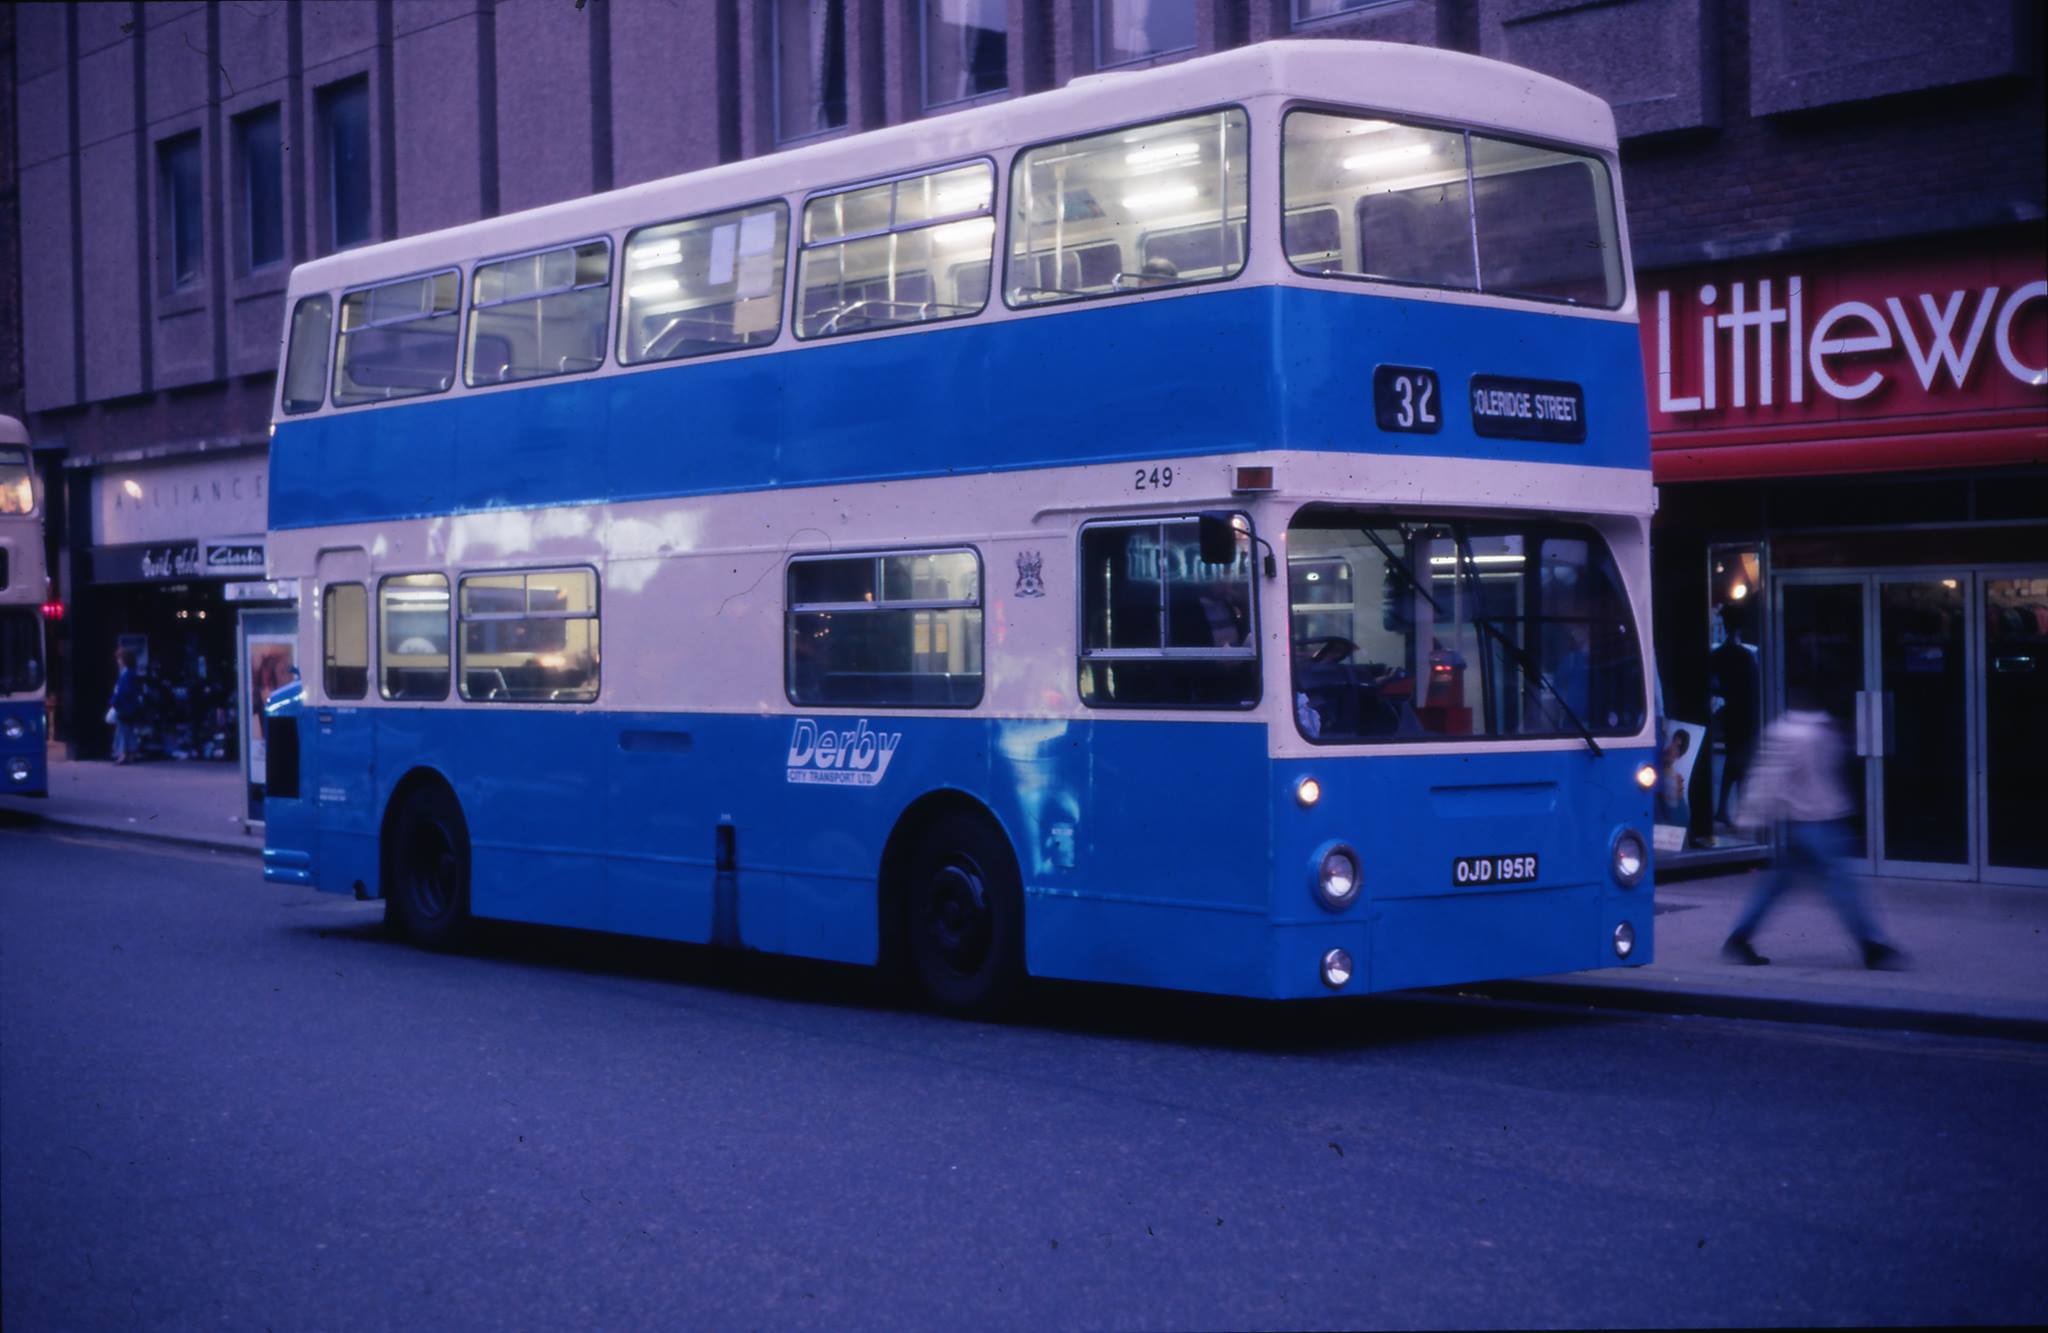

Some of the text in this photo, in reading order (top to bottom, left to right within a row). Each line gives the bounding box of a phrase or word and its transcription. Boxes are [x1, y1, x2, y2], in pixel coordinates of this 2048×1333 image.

[1395, 374, 1436, 427] 32
[1535, 394, 1577, 421] STREET
[1135, 466, 1173, 490] 249
[787, 718, 902, 785] Derby
[789, 770, 806, 781] CITY
[809, 771, 856, 782] TRANSPORT
[1457, 857, 1536, 882] OJD 195R
